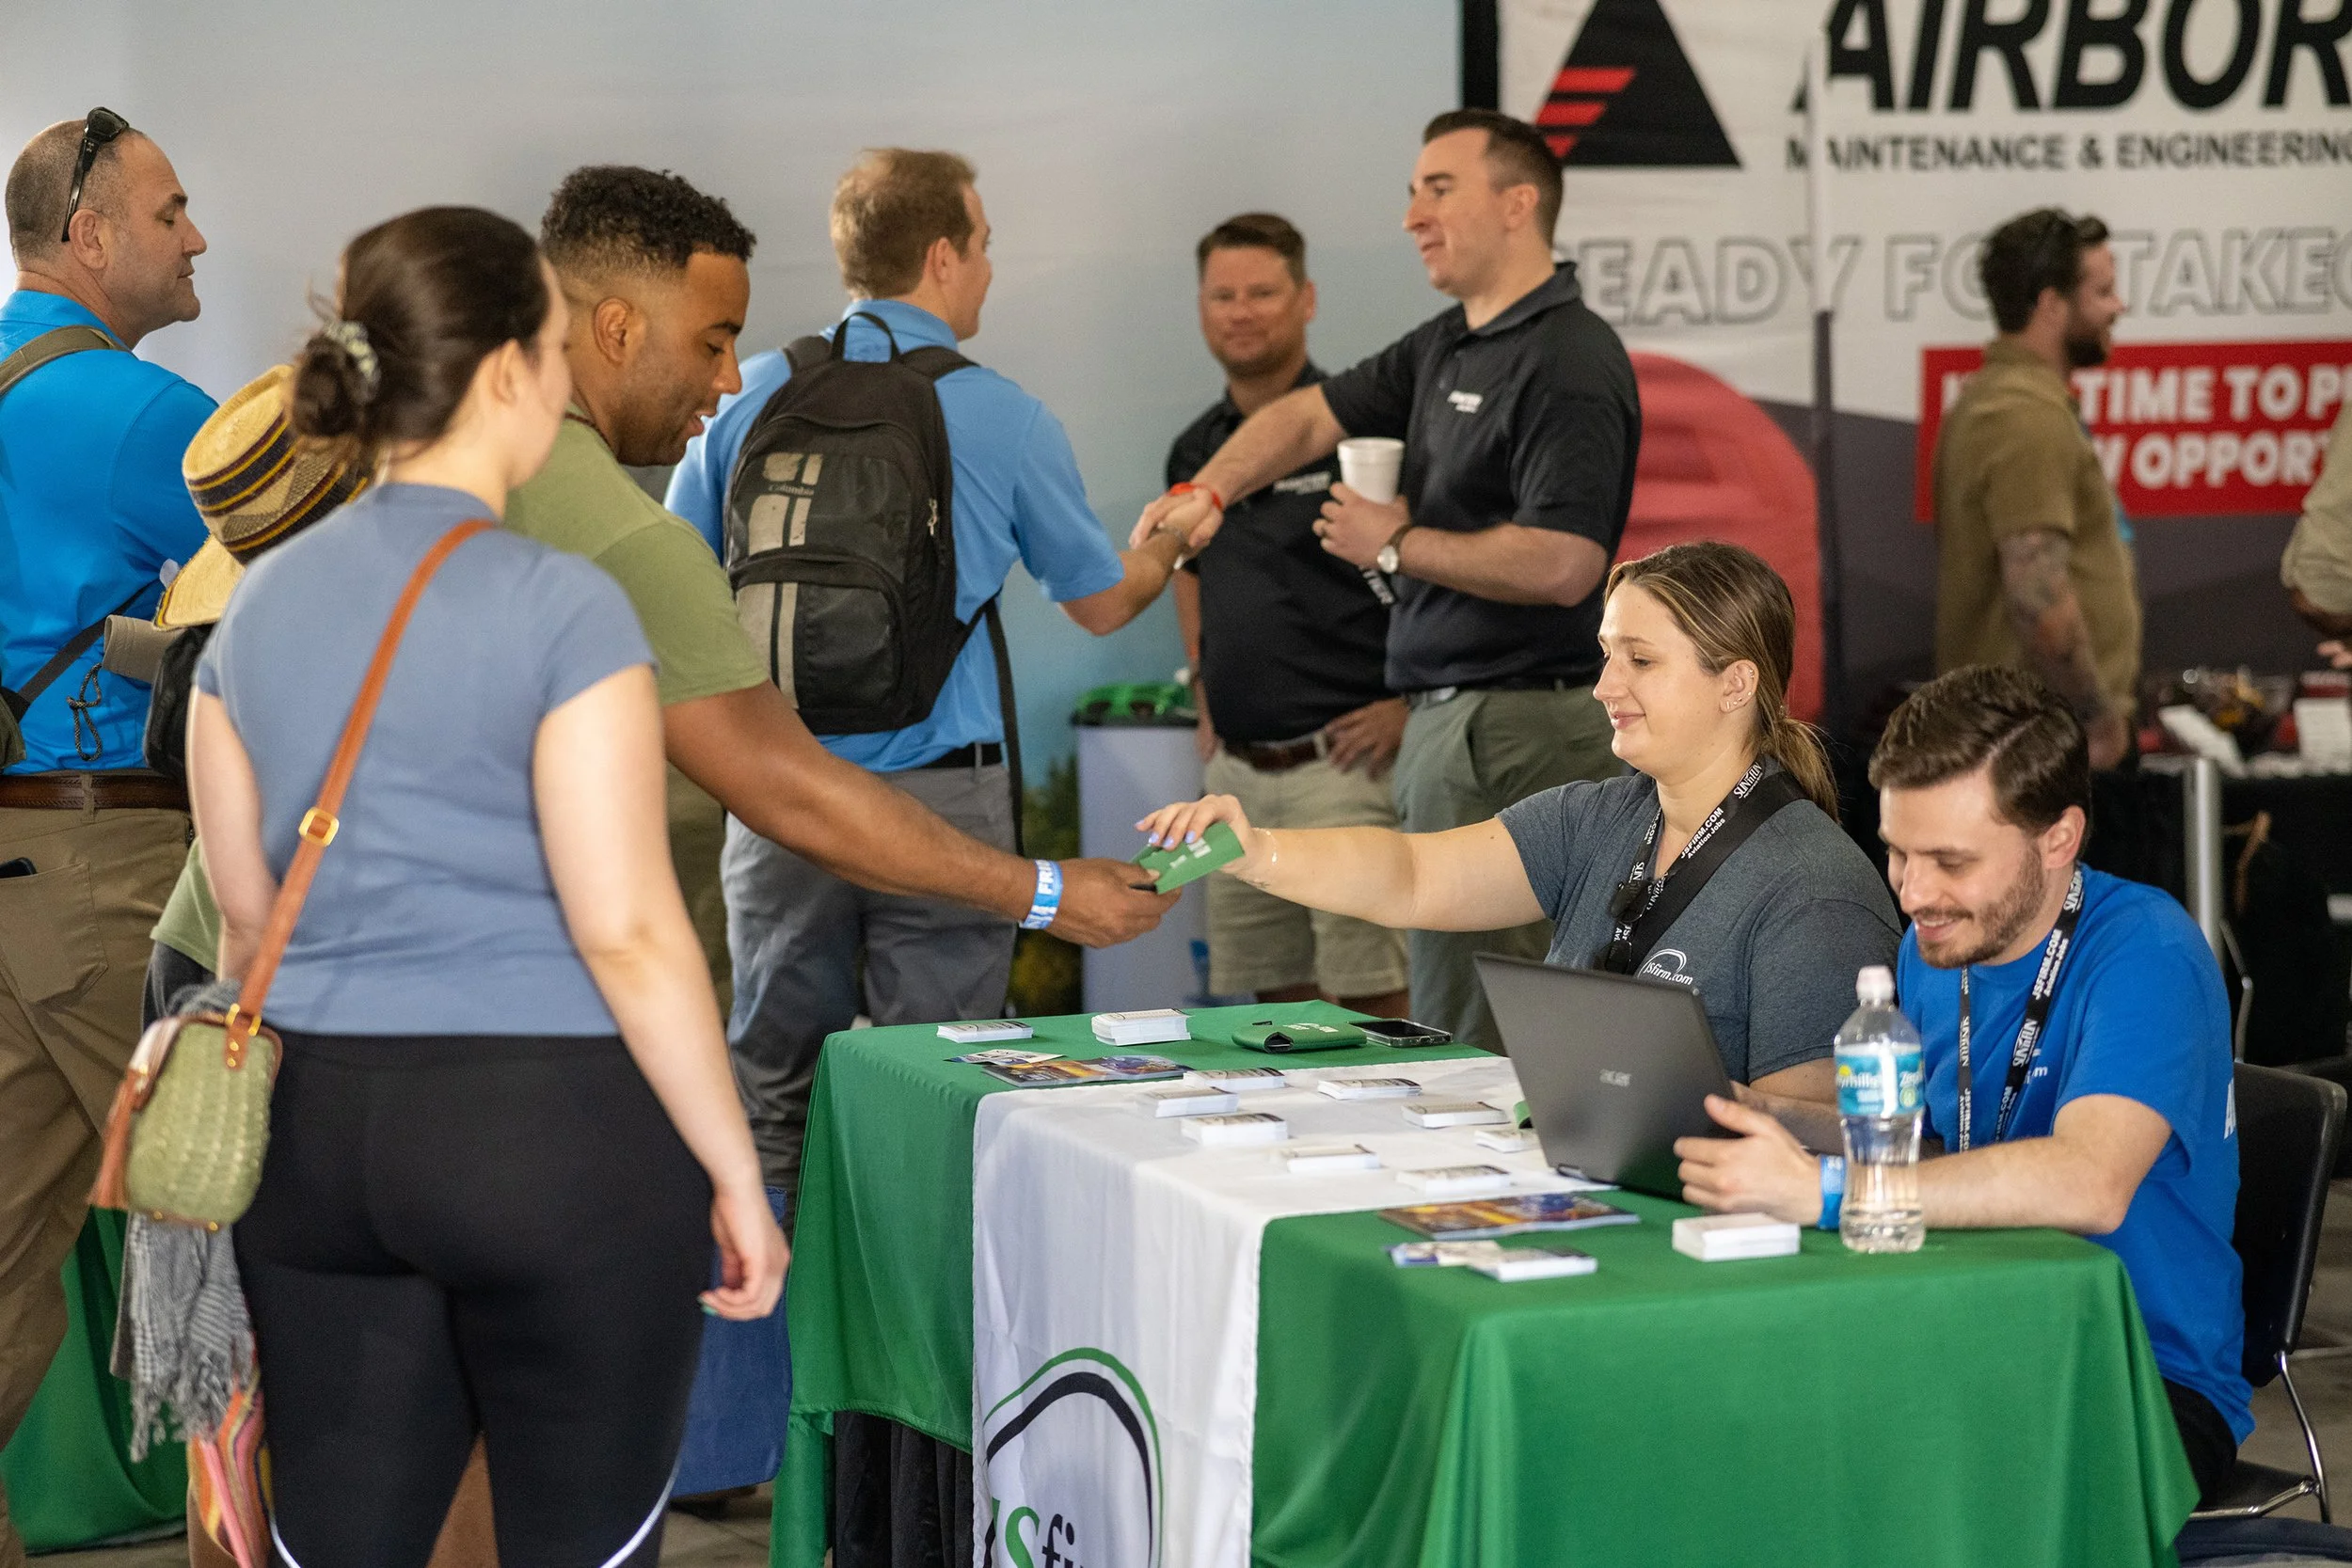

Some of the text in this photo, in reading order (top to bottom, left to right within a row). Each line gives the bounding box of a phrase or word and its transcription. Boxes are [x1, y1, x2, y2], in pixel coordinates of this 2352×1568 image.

[1789, 0, 2352, 116] AIRBOR
[2078, 135, 2104, 170] &
[1558, 238, 1861, 326] EADY
[2072, 366, 2215, 423] TIME
[2224, 364, 2302, 420] TO
[1680, 807, 1724, 859] JSFIRM.COM
[1687, 817, 1725, 859] Aviation Jobs
